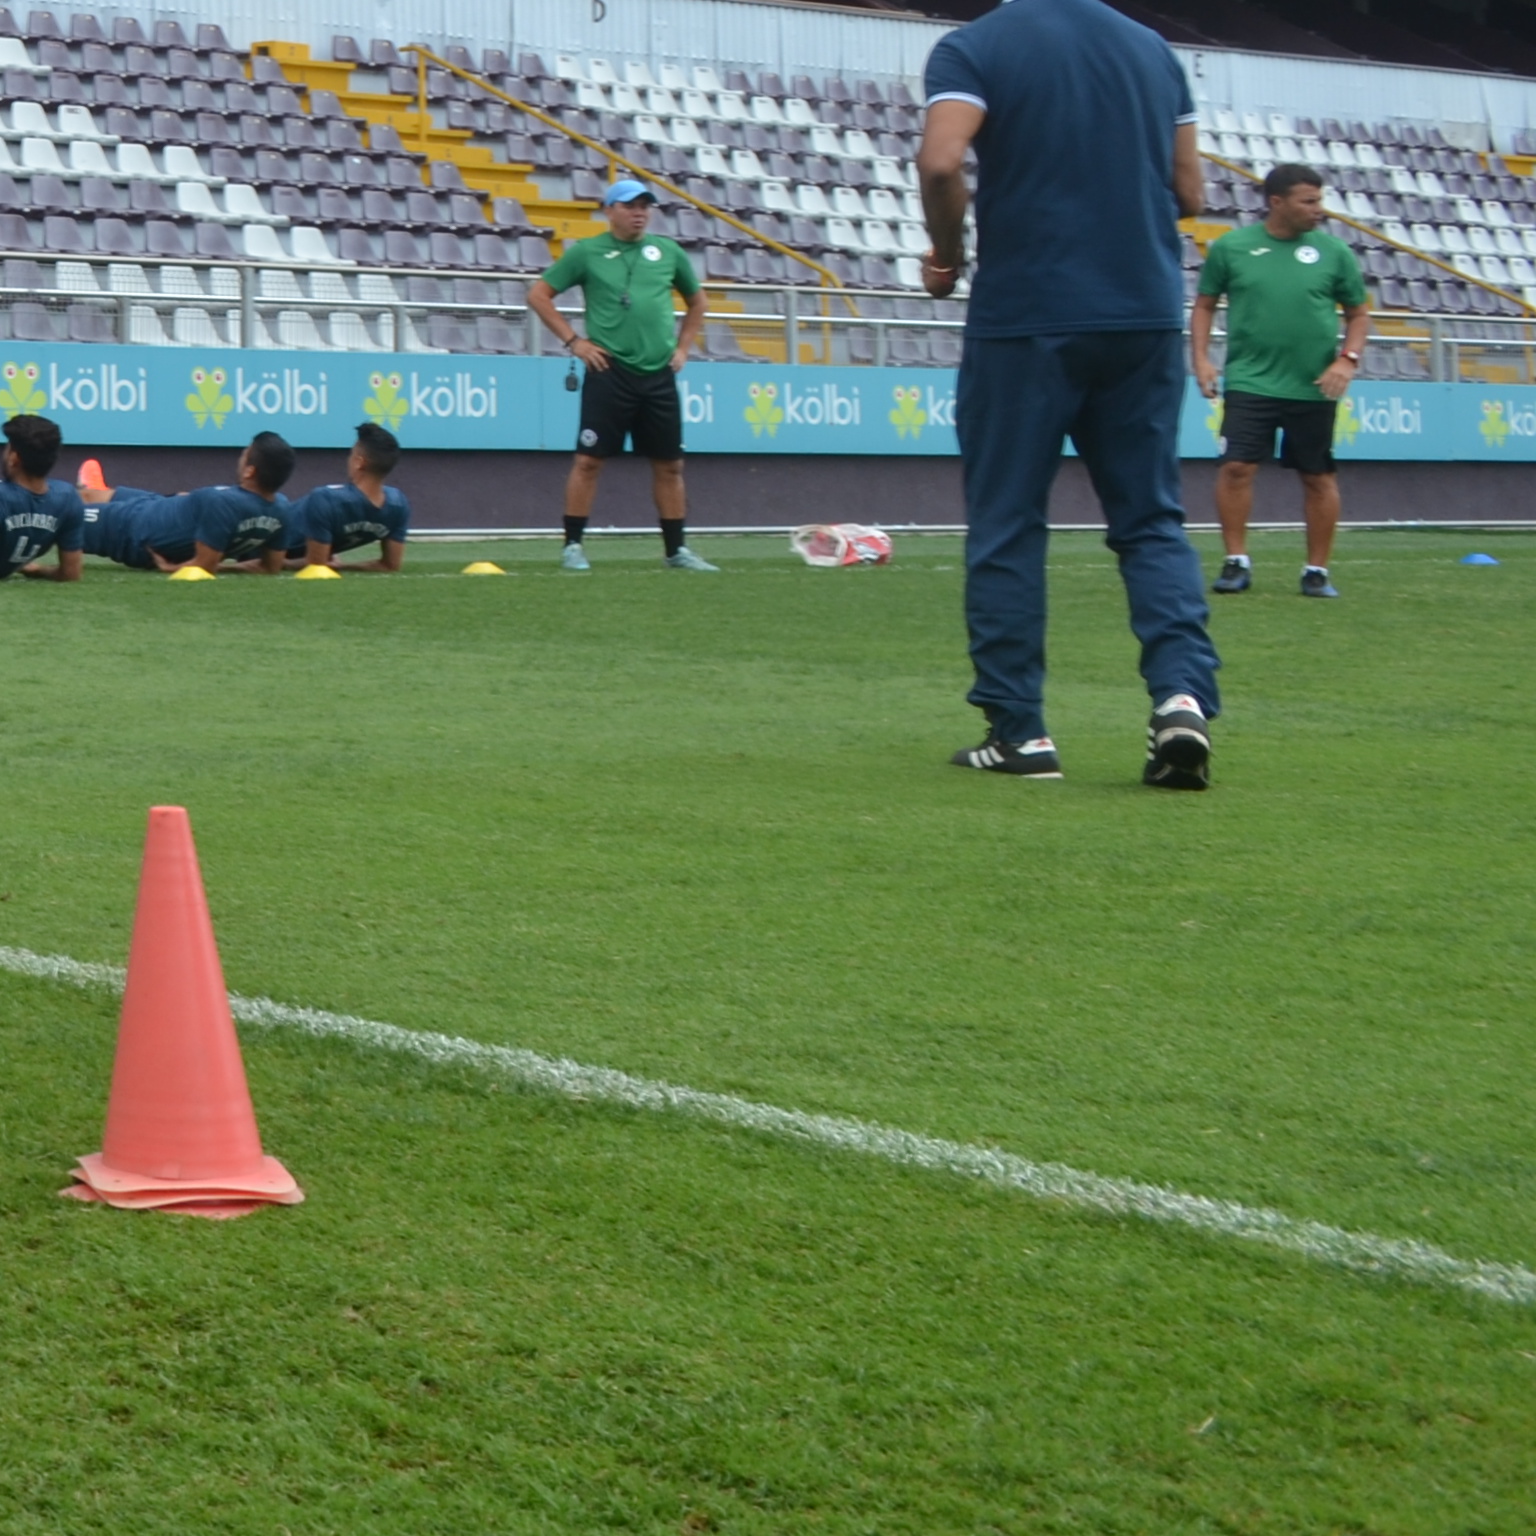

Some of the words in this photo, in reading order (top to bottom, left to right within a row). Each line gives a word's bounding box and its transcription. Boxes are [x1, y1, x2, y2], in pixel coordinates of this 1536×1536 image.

[50, 362, 148, 412] kölbi
[235, 367, 328, 415] kölbi
[410, 371, 497, 417] kölbi
[784, 382, 861, 425] kölbi
